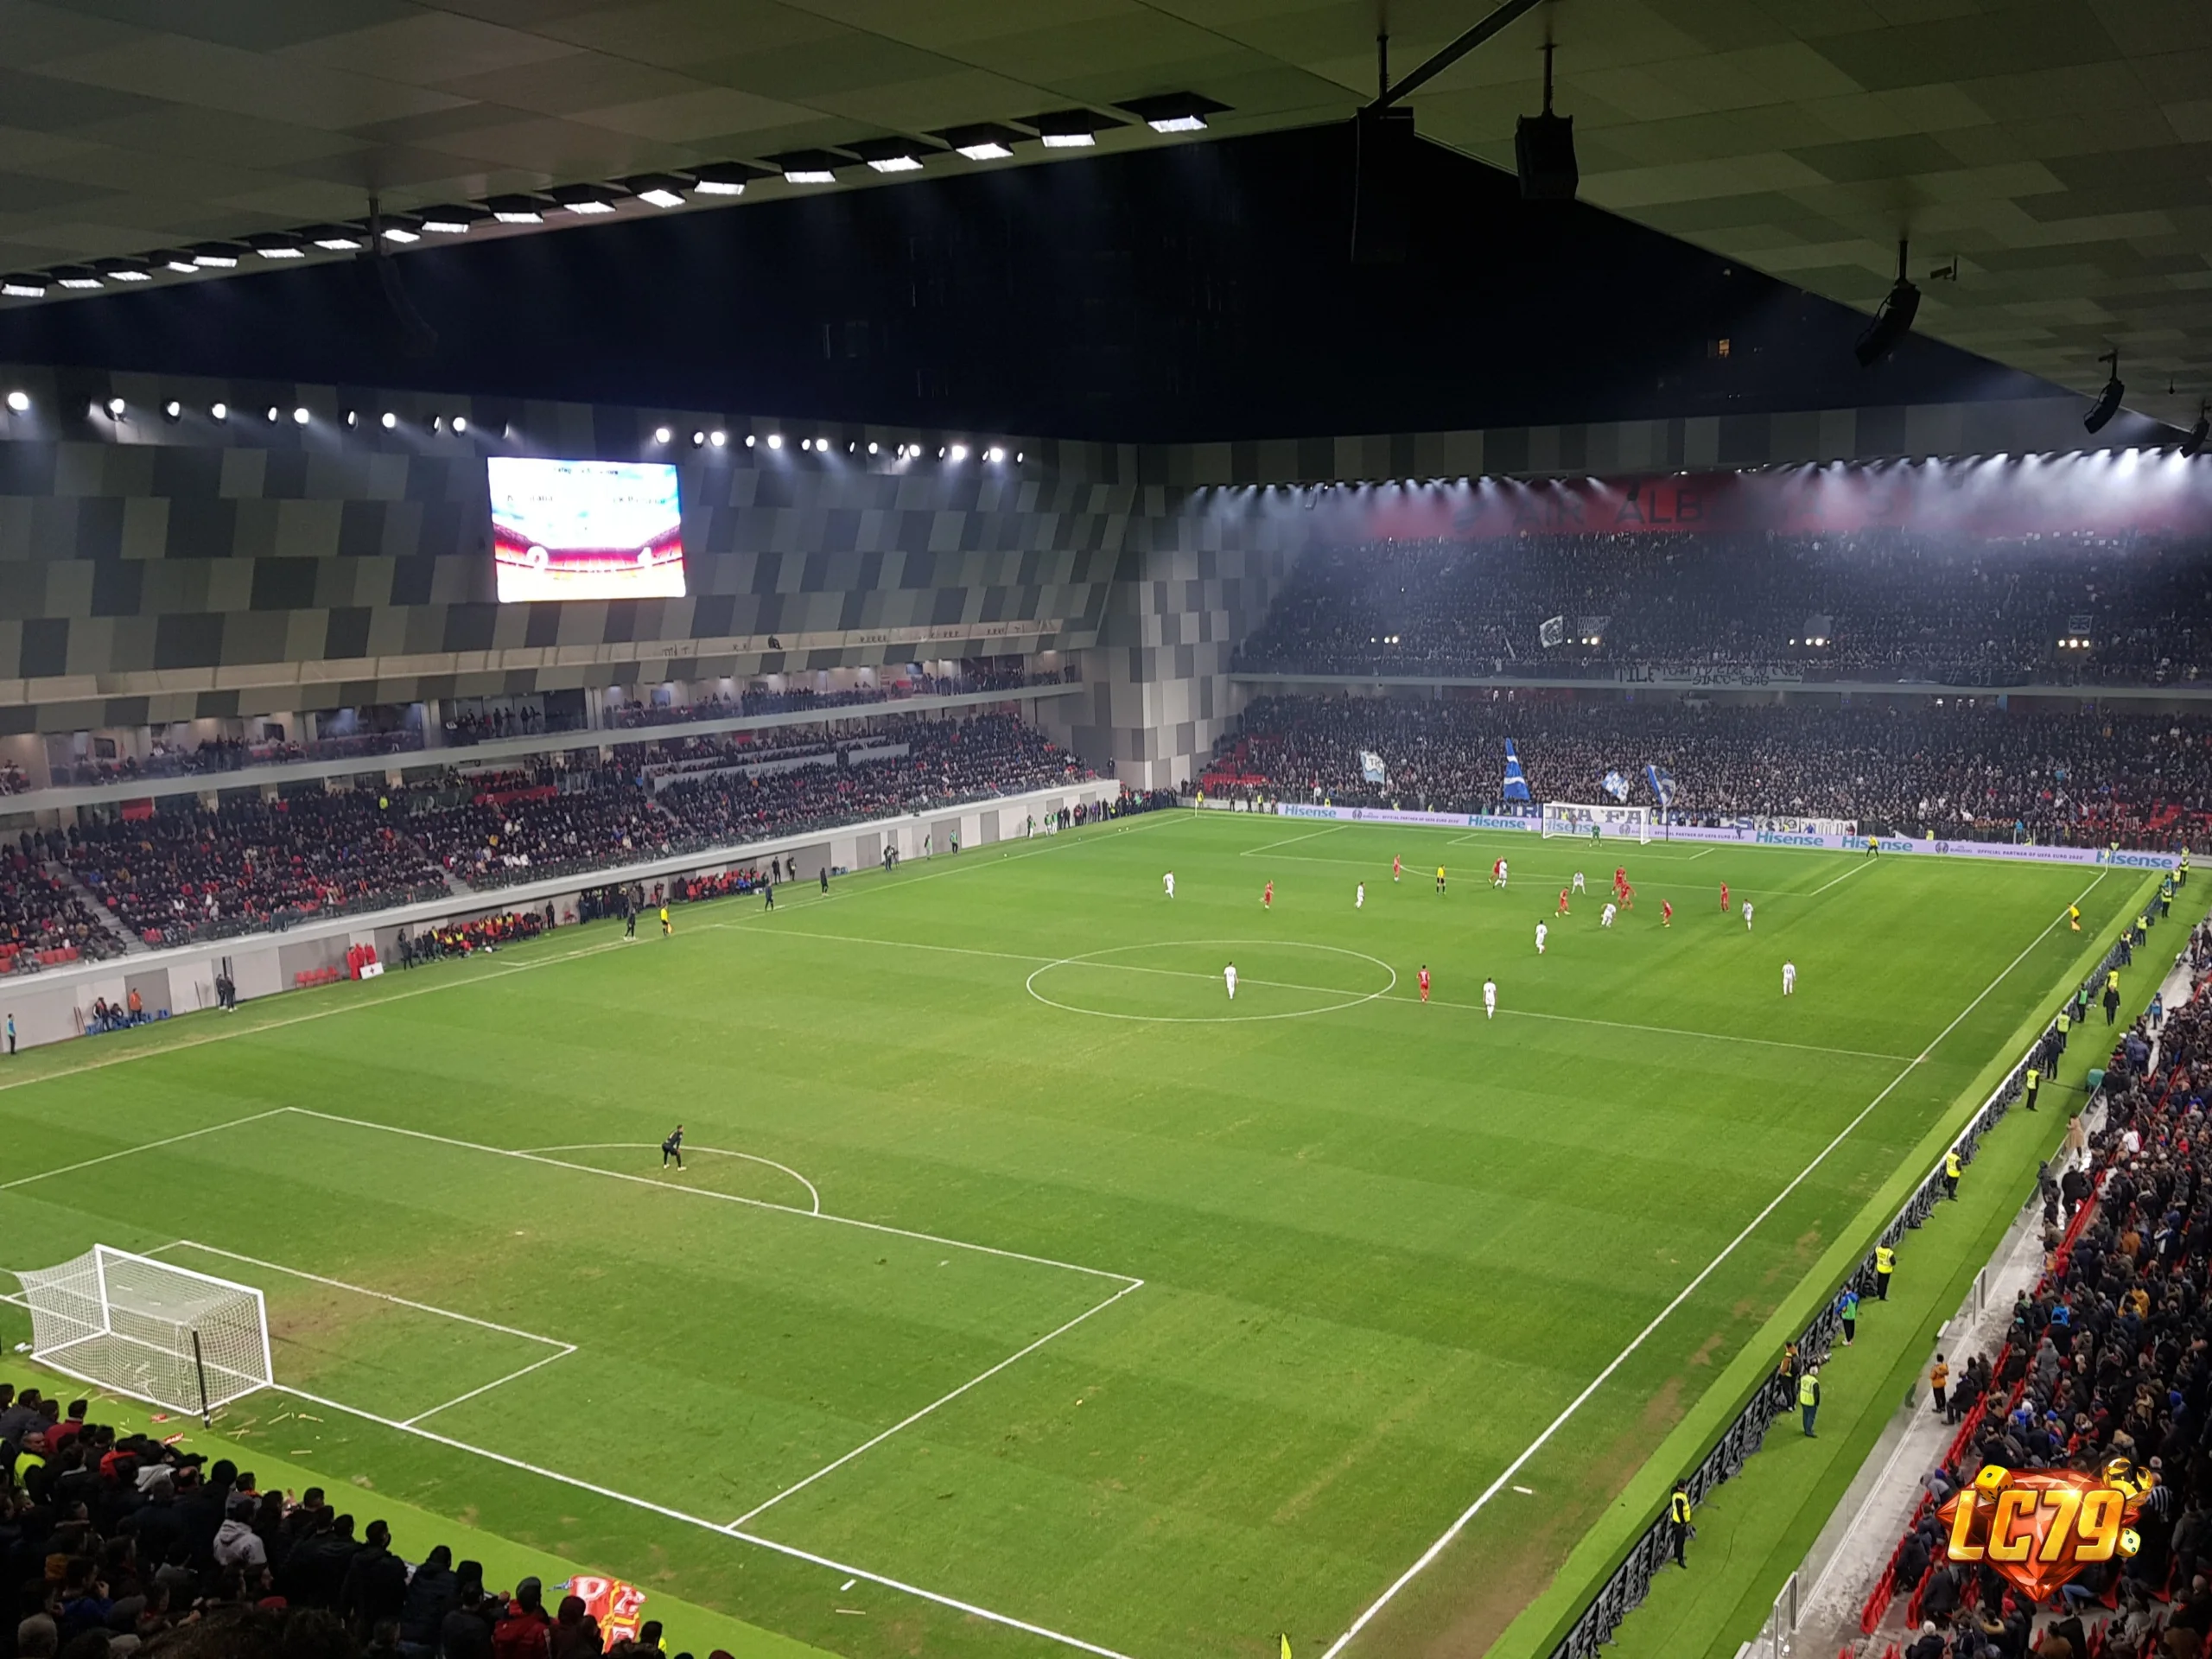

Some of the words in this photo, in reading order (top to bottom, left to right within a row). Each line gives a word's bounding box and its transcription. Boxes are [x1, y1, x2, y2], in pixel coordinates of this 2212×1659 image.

[1285, 804, 1337, 818] Hisense
[1468, 815, 1526, 830] Hisense
[1756, 830, 1825, 847] Hisense
[2096, 850, 2173, 869] Hisense
